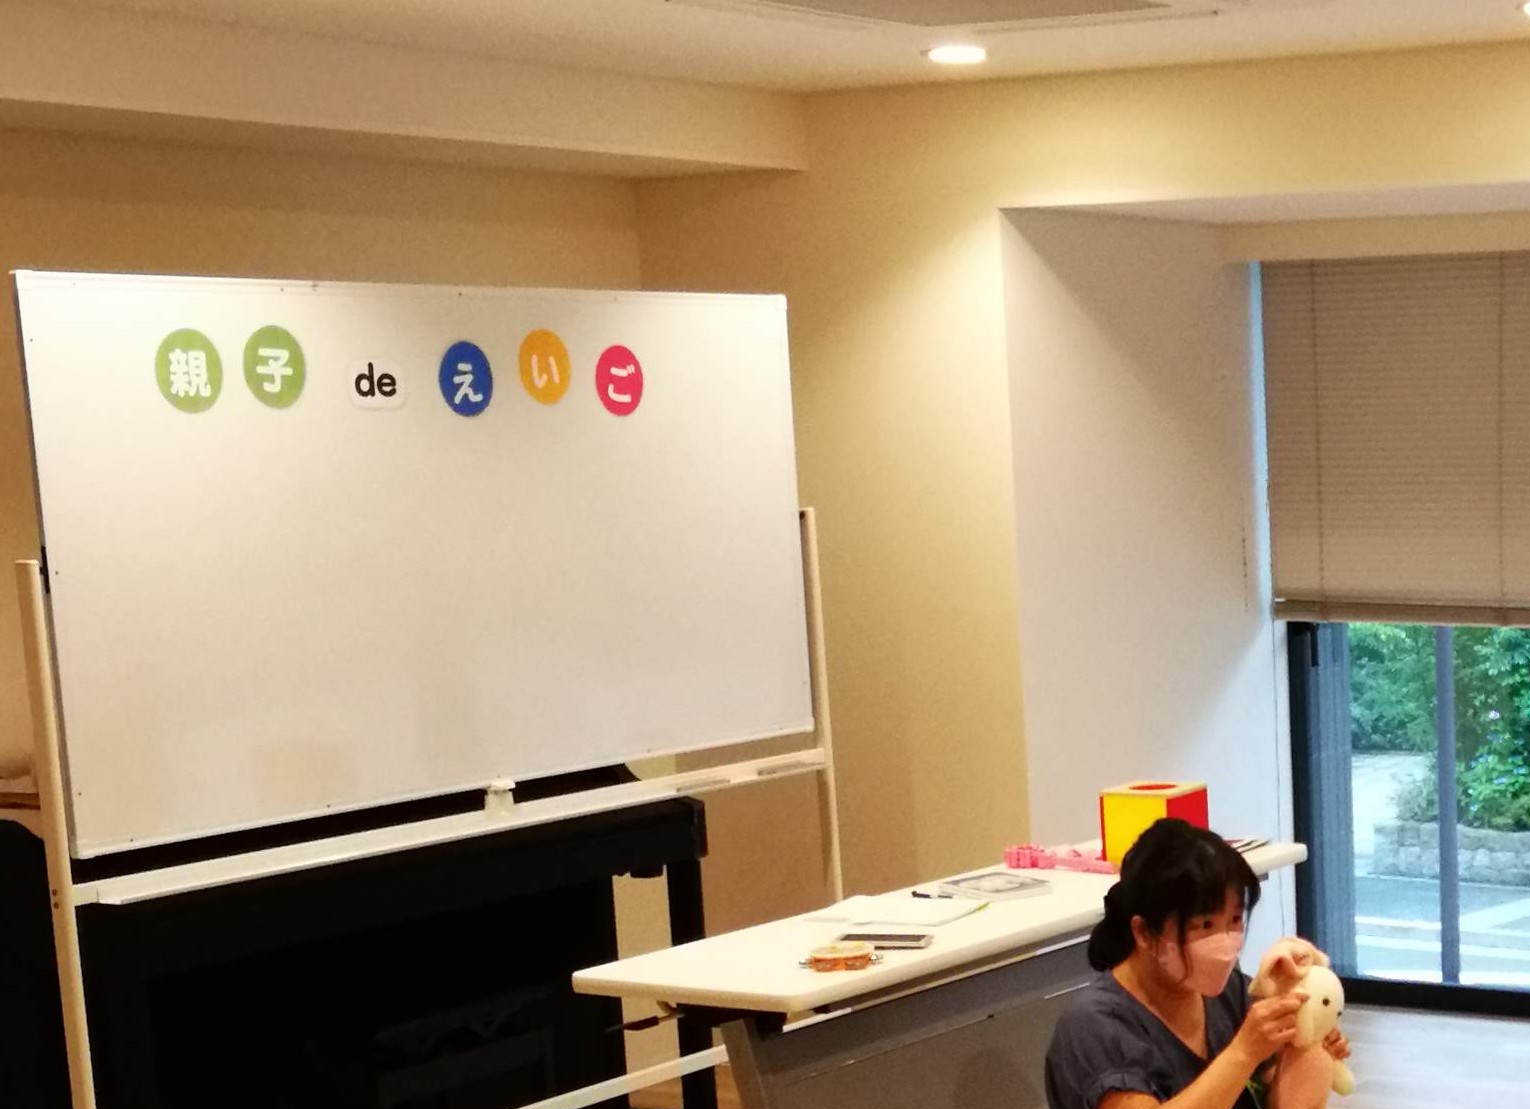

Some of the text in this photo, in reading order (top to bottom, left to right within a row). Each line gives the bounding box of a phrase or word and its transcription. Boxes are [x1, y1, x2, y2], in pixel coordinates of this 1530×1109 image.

[168, 348, 634, 404] 親子 de えいご
